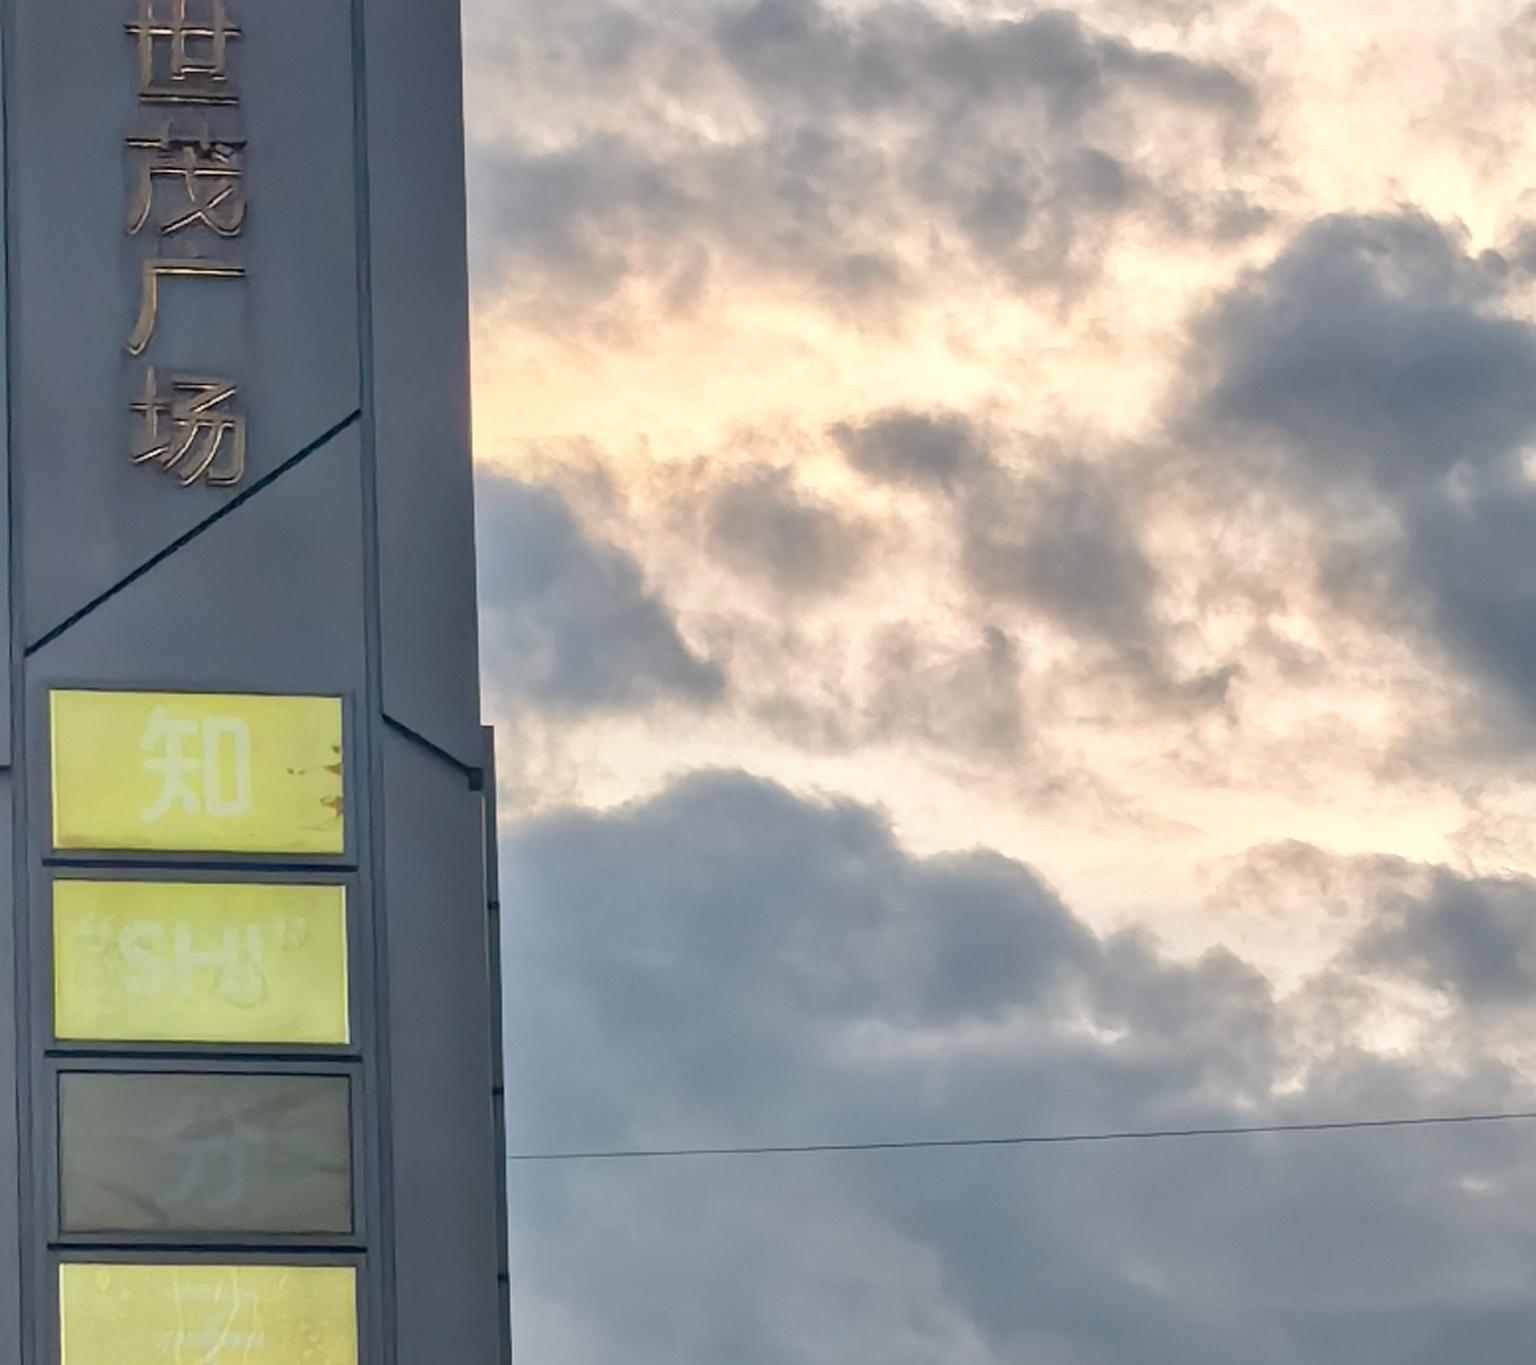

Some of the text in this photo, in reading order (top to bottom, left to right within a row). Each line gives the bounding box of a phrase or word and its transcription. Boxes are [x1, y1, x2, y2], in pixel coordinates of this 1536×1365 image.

[123, 0, 248, 486] 世茂广场
[140, 705, 253, 822] 知
